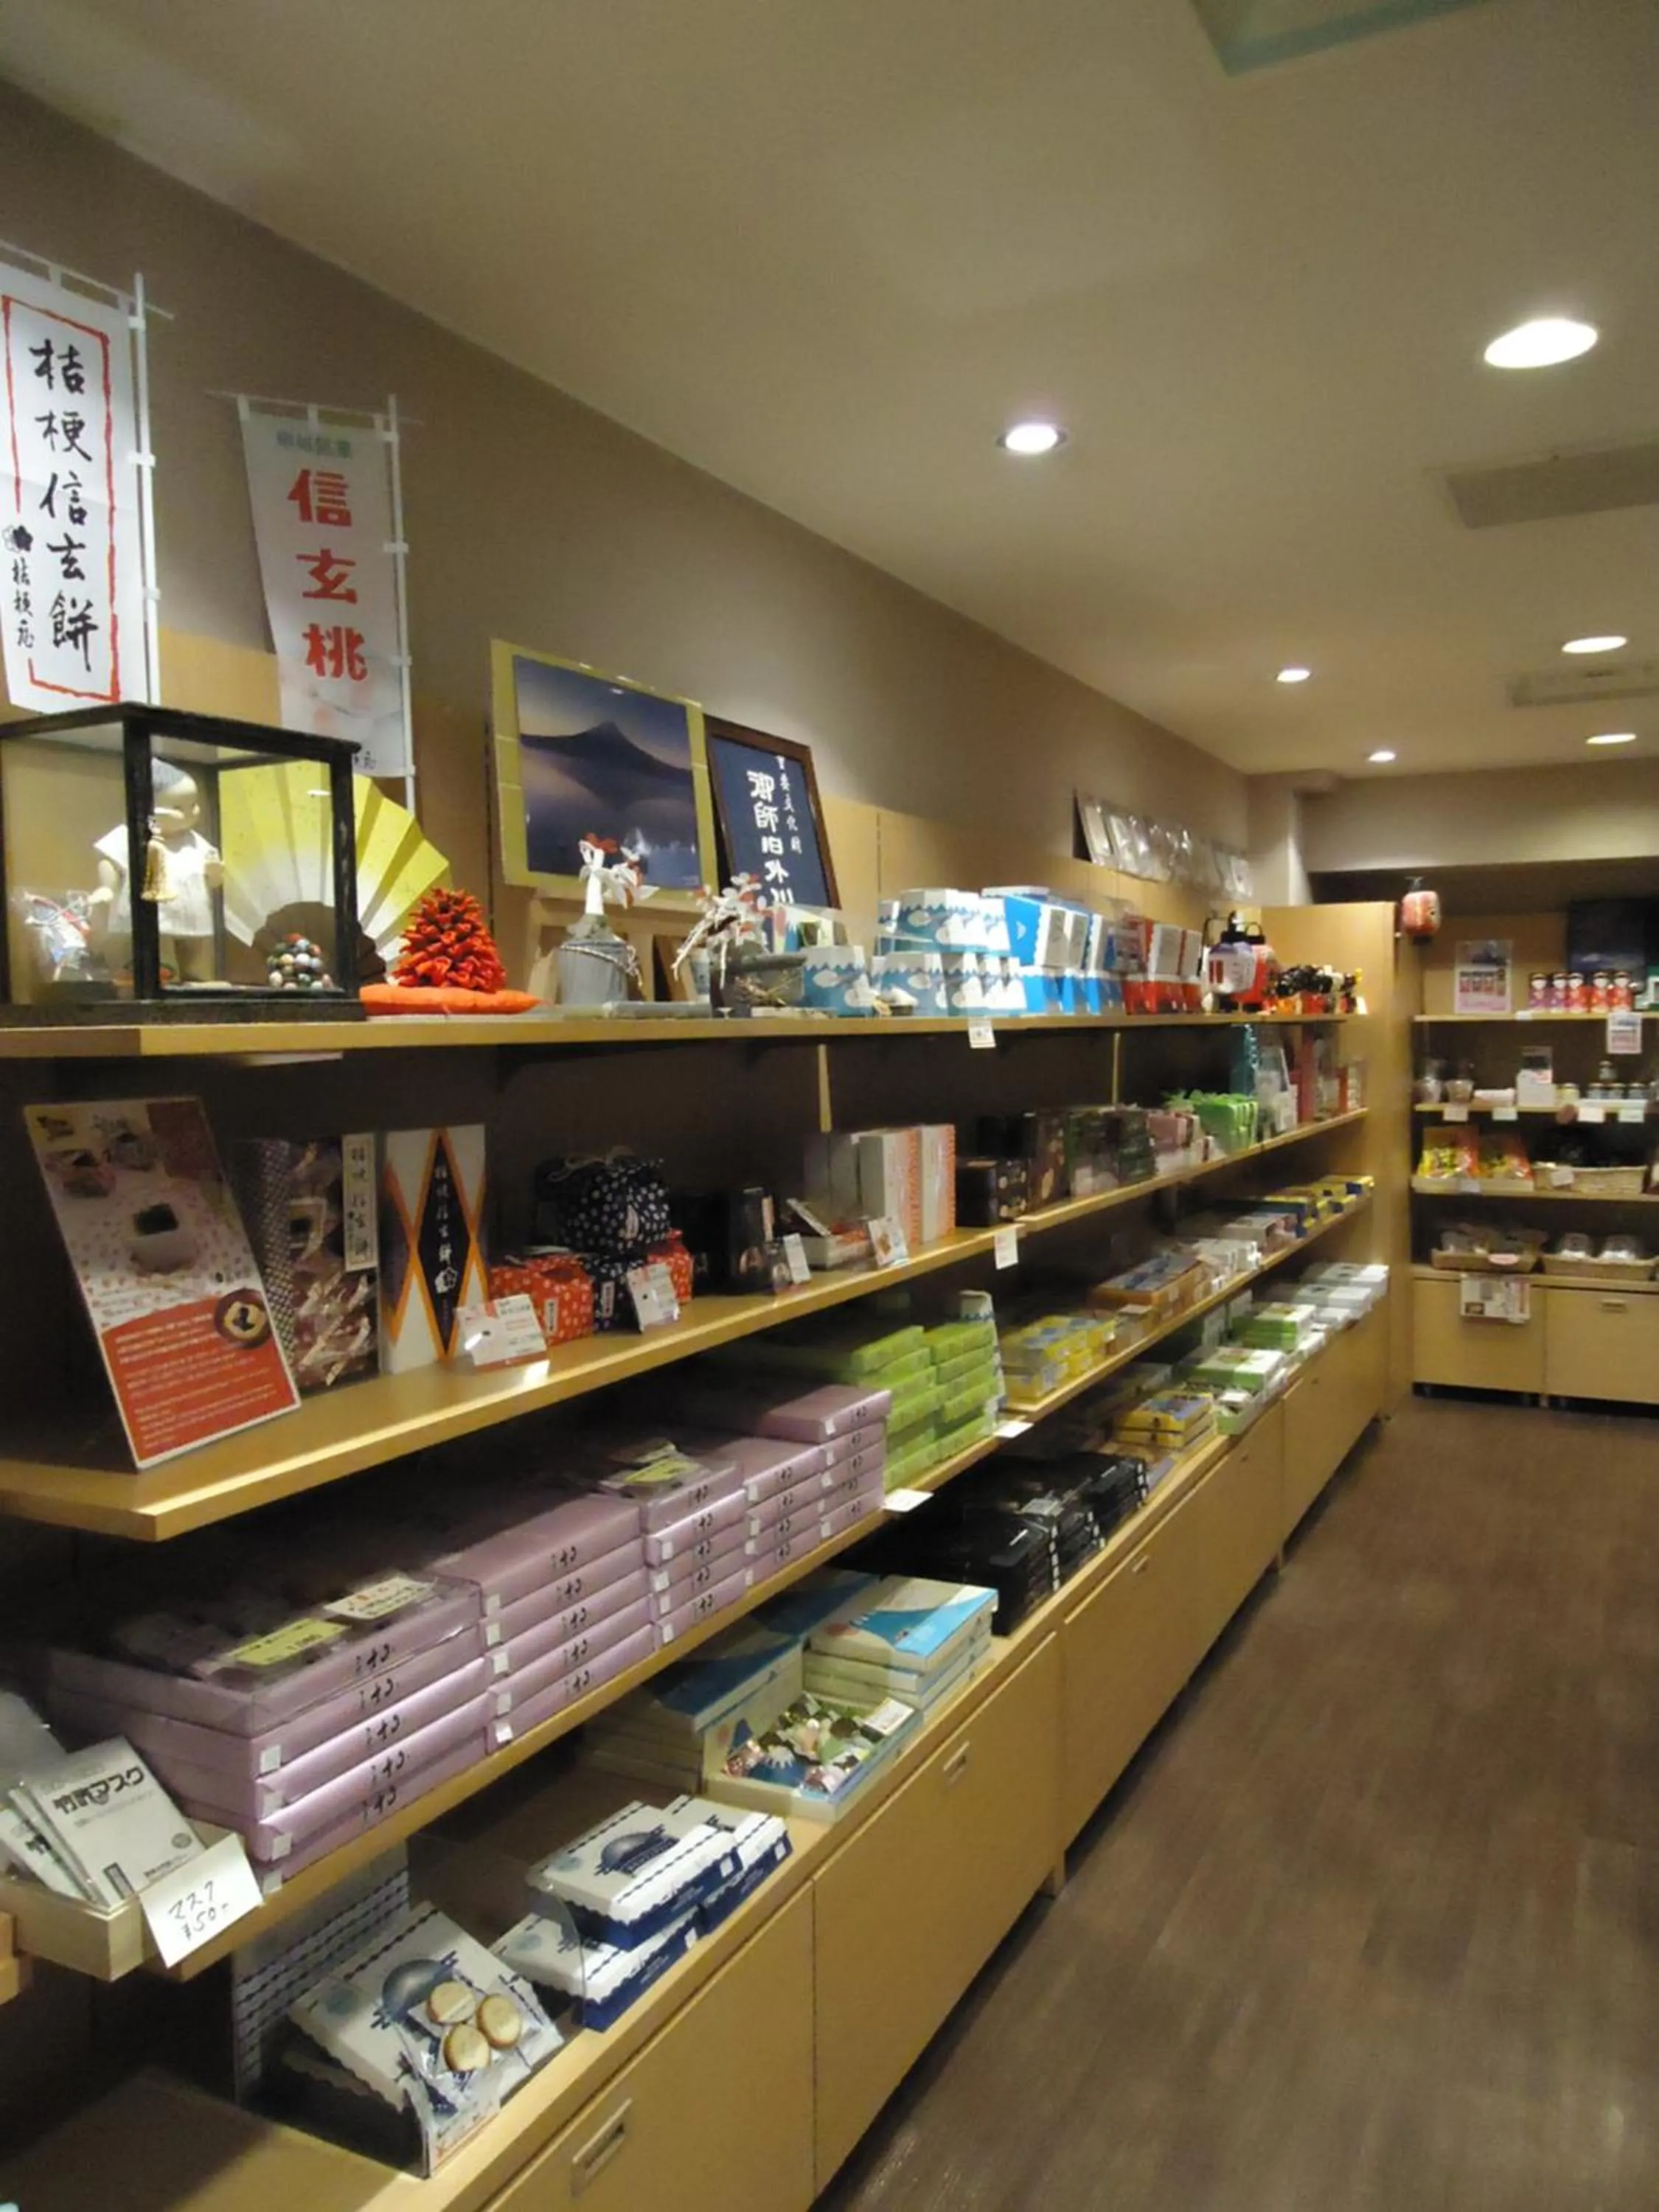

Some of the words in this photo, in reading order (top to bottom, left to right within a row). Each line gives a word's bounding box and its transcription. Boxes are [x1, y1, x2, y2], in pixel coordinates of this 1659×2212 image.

[29, 338, 99, 672] 桔梗信玄餅
[287, 468, 368, 681] 信玄桃
